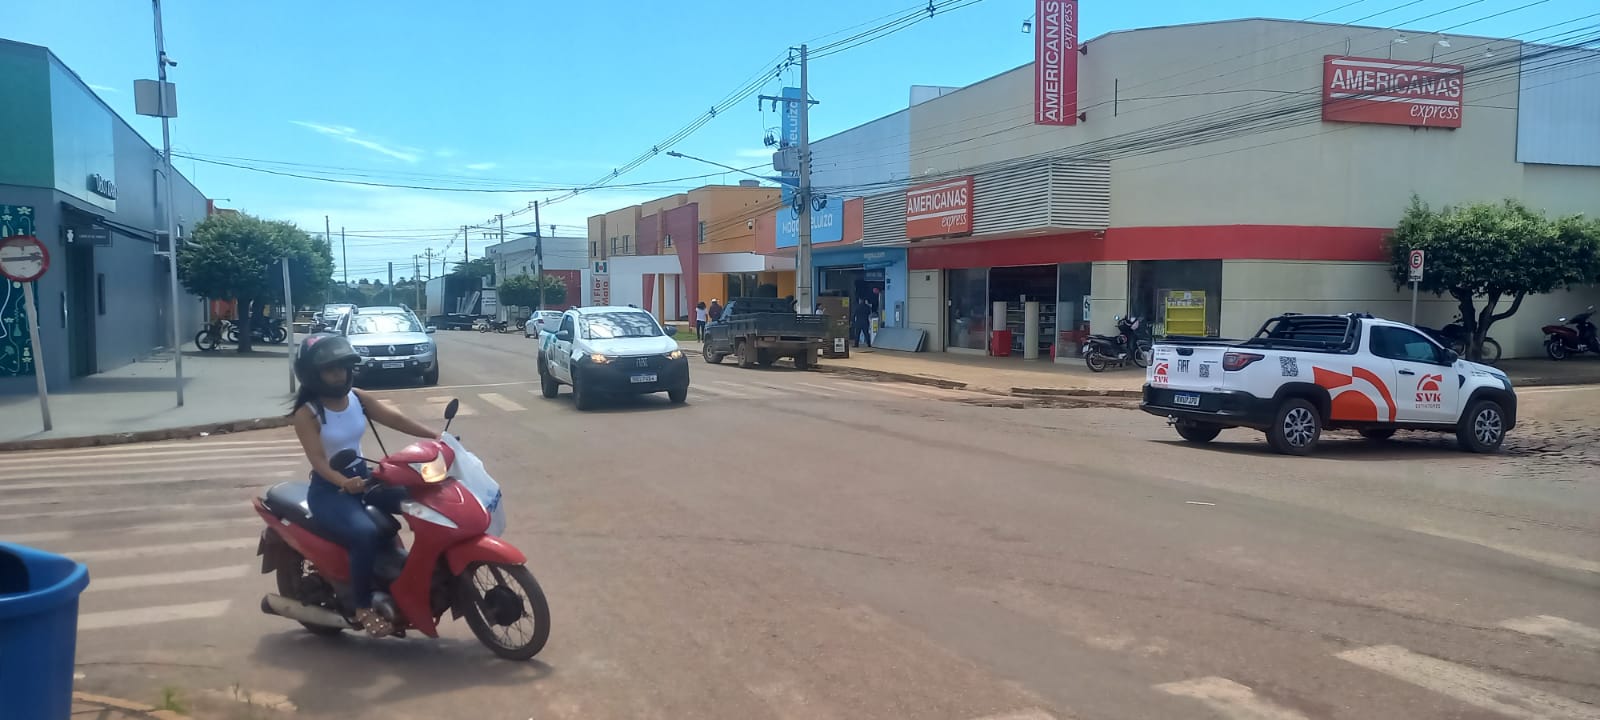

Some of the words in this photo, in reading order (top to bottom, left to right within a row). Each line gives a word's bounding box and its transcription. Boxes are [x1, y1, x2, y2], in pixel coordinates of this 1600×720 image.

[1064, 3, 1076, 50] express
[1046, 1, 1059, 122] AMERICANAS
[1331, 68, 1460, 98] AMERICANAS
[1410, 104, 1459, 125] express
[907, 187, 967, 214] AMERICANAS
[941, 213, 967, 233] express
[593, 278, 601, 297] Flor
[1177, 359, 1191, 373] FIAT
[1153, 375, 1169, 383] SVK
[1416, 393, 1441, 402] SVK
